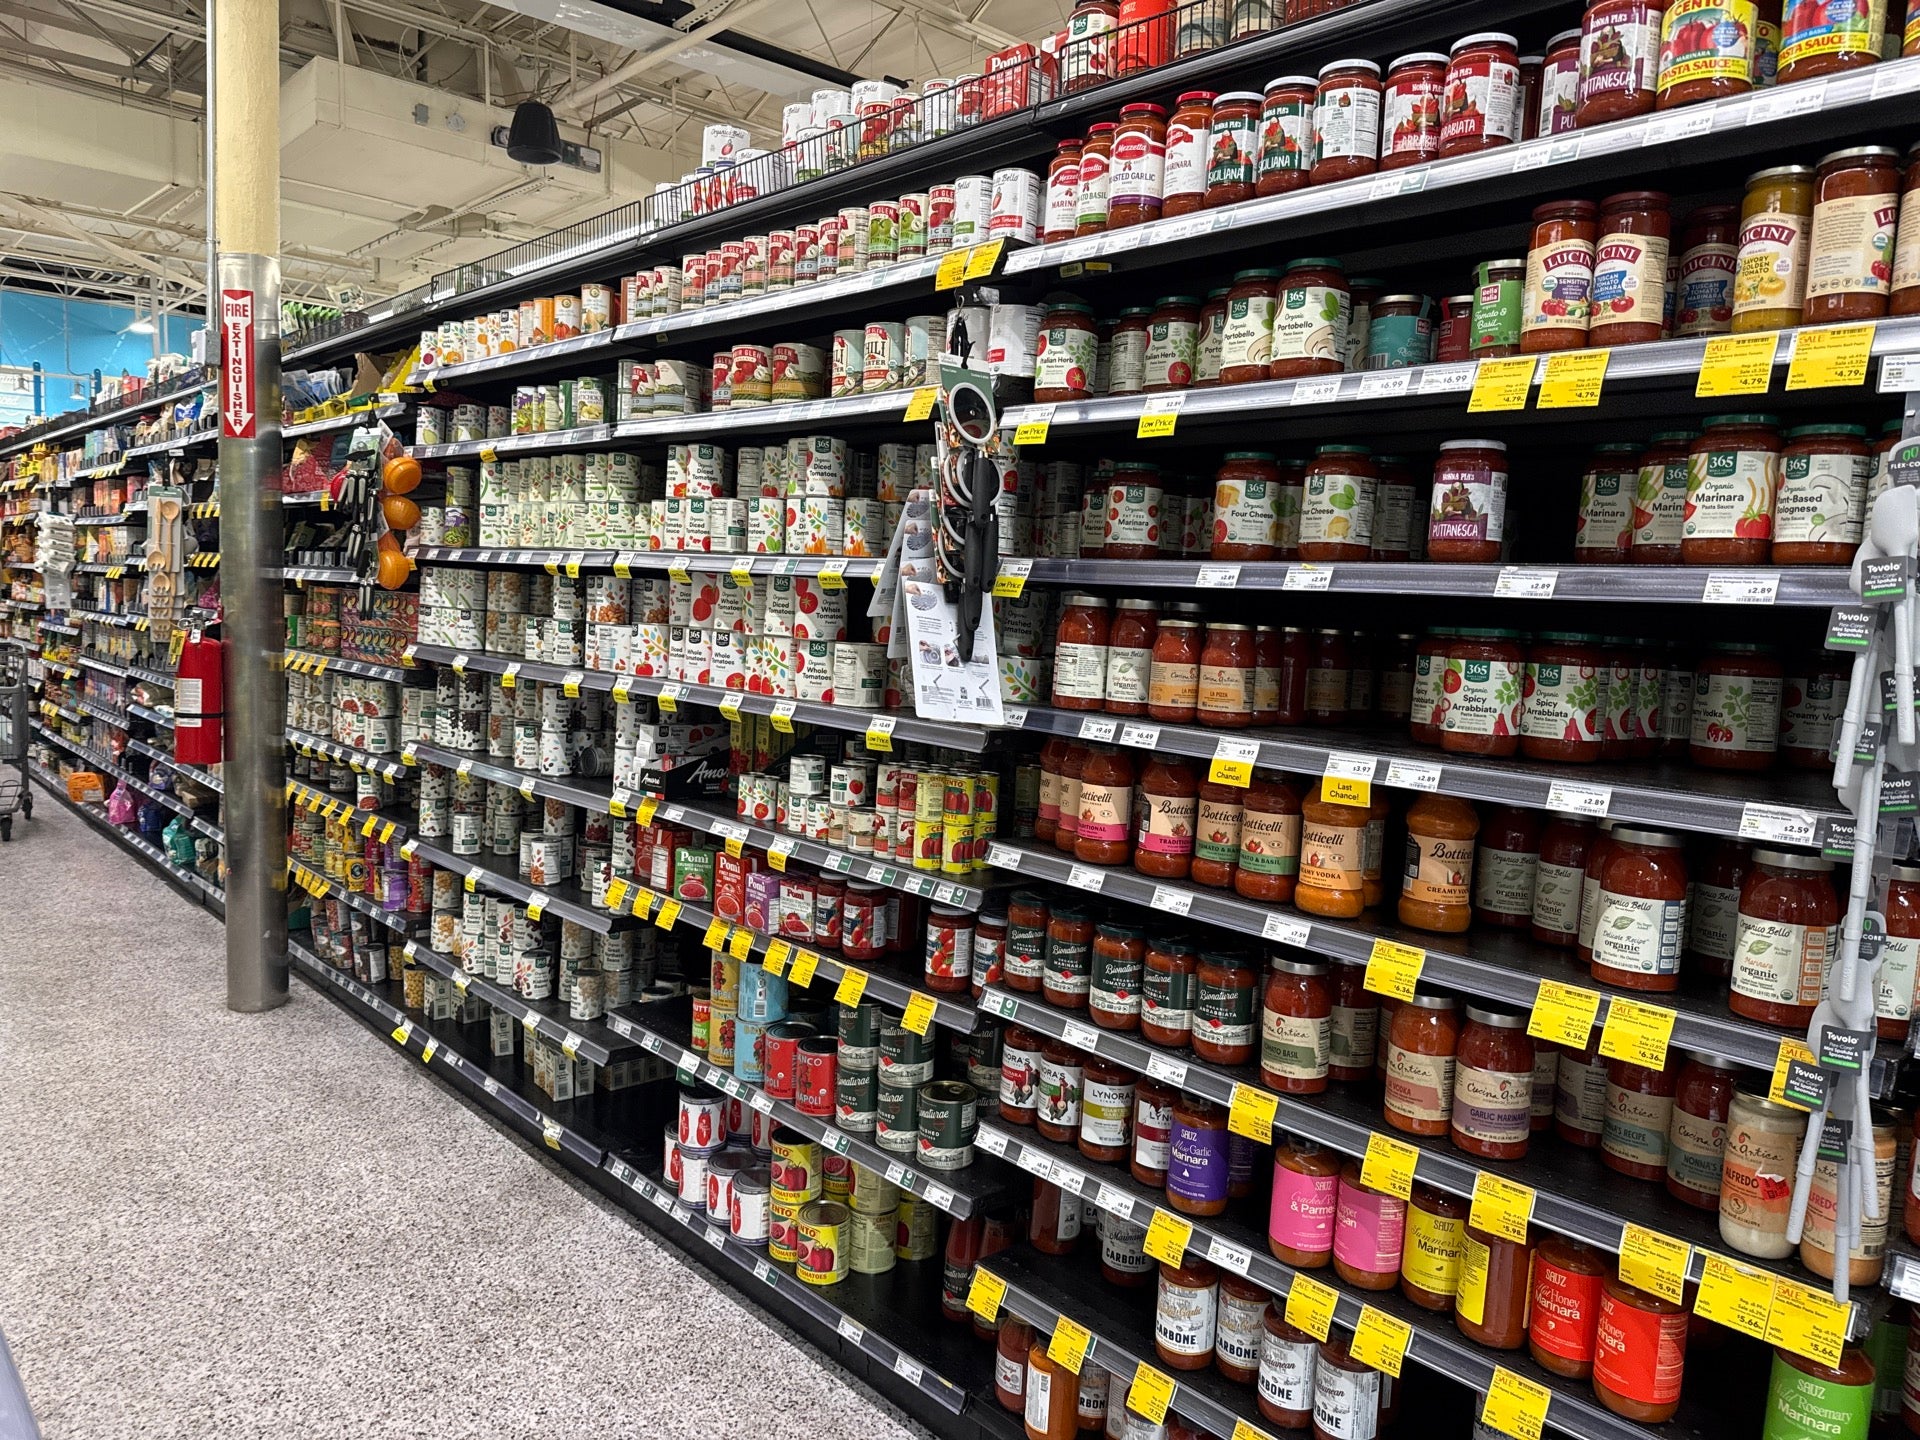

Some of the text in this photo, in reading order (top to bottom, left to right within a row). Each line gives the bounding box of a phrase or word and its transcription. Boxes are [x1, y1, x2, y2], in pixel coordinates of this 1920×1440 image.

[1805, 35, 1845, 52] SAUCE
[1676, 50, 1711, 62] MARINARA
[1661, 59, 1731, 82] PASTA SAUCE
[1117, 143, 1147, 153] Mezzetta
[1128, 172, 1156, 182] GARLIC
[1089, 192, 1107, 200] BASIL
[1743, 256, 1769, 266] SAVORY
[1742, 262, 1770, 272] GOLDEN
[1742, 268, 1769, 277] TOMATO
[1559, 278, 1588, 287] SENSITIVE
[1288, 291, 1304, 302] 365
[225, 303, 249, 318] FIRE
[1234, 302, 1247, 313] 365
[1285, 313, 1304, 322] Organic
[1277, 320, 1313, 332] Portobello
[1477, 319, 1501, 330] Basil
[1153, 325, 1167, 335] 365
[1224, 330, 1255, 340] Portobello
[1050, 331, 1064, 341] 365
[1800, 335, 1825, 344] SALE
[1708, 344, 1731, 352] SALE
[1160, 351, 1176, 359] Herb
[232, 322, 243, 427] EXTINGUISHER
[1381, 380, 1403, 390] $6.99
[1443, 375, 1467, 385] $6.99
[1313, 386, 1334, 397] $6.99
[1141, 418, 1173, 428] Low Price
[1018, 428, 1046, 437] Low Price
[817, 440, 830, 449] 365
[1710, 455, 1734, 468] 365
[1787, 460, 1807, 471] 365
[813, 463, 832, 471] Diced
[809, 470, 837, 478] Tomatoes
[1597, 477, 1617, 488] 365
[1705, 482, 1734, 491] Organic
[1128, 488, 1143, 498] 365
[1247, 483, 1264, 493] 365
[1784, 485, 1806, 493] Organic
[1695, 494, 1744, 503] Marinara
[1244, 501, 1264, 510] Organic
[1593, 500, 1617, 508] Organic
[1311, 507, 1334, 515] Cheese
[1585, 509, 1625, 518] Marinara
[1777, 505, 1818, 514] Bolognese
[1231, 510, 1274, 520] Four Cheese
[1118, 518, 1149, 527] Marinara
[1432, 523, 1478, 538] PUTTANESCA
[1867, 563, 1901, 573] Tovolo
[775, 577, 789, 586] 365
[995, 581, 1022, 589] Low Price
[773, 601, 790, 609] Diced
[821, 606, 841, 614] Whole
[769, 607, 795, 615] Tomatoes
[1838, 612, 1870, 621] Tovolo
[717, 633, 729, 642] 365
[811, 642, 827, 652] 365
[712, 658, 735, 666] Tomatoes
[807, 667, 828, 675] Whole
[1466, 664, 1487, 676] 365
[1539, 668, 1559, 680] 365
[802, 673, 832, 681] Tomatoes
[1113, 682, 1137, 691] organic
[1463, 685, 1488, 694] Organic
[1536, 690, 1559, 698] Organic
[1463, 694, 1487, 705] Spicy
[1536, 699, 1558, 709] Spicy
[1452, 704, 1497, 714] Arrabbiata
[1526, 707, 1568, 718] Arrabbiata
[1702, 710, 1723, 718] Vodka
[1096, 727, 1112, 735] $9.49
[1137, 732, 1154, 741] $6.49
[1239, 749, 1255, 757] $3.97
[1224, 765, 1237, 773] Last
[1353, 765, 1371, 774] $3.97
[1216, 772, 1242, 782] Chance!
[1417, 775, 1436, 783] $2.89
[1337, 783, 1352, 792] Last
[1880, 780, 1911, 788] Tovolo
[1330, 791, 1359, 801] Chance!
[1584, 798, 1605, 807] $2.89
[1784, 825, 1809, 834] $2.59
[1261, 858, 1281, 866] BASIL
[1316, 871, 1341, 880] VODKA
[1427, 886, 1458, 895] CREAMY
[1496, 889, 1528, 898] organic
[1604, 895, 1651, 911] Organico Bello
[1740, 920, 1791, 938] Organico Bello
[1012, 930, 1044, 940] Bionaturae
[1291, 931, 1307, 939] $7.59
[1013, 944, 1040, 953] MARINARA
[1605, 939, 1640, 952] organic
[1054, 961, 1083, 969] MARINARA
[1744, 957, 1773, 969] Marinara
[1740, 965, 1778, 981] organic
[1541, 987, 1560, 997] SALE
[1614, 1004, 1632, 1016] SALE
[1827, 1031, 1859, 1045] Tovolo
[1282, 1049, 1298, 1059] BASIL
[1781, 1046, 1805, 1060] SALE
[1170, 1070, 1183, 1079] $9.69
[1794, 1066, 1824, 1082] Tovolo
[1392, 1085, 1411, 1096] VODKA
[1467, 1082, 1498, 1099] Cucina
[1470, 1108, 1527, 1123] GARLIC MARINARA
[1181, 1129, 1197, 1142] SAUZ
[1624, 1128, 1646, 1142] RECIPE
[1678, 1125, 1709, 1145] Cucina
[1190, 1145, 1211, 1156] Garlic
[1172, 1148, 1208, 1166] Marinara
[1684, 1154, 1716, 1172] NONNA'S
[1725, 1165, 1759, 1189] ALFREDO
[1315, 1181, 1332, 1191] SAUZ
[1479, 1179, 1496, 1190] SALE
[1291, 1202, 1298, 1212] &
[1434, 1219, 1454, 1233] SAUZ
[1626, 1231, 1647, 1244] SALE
[1106, 1247, 1147, 1266] CARBONE
[1226, 1253, 1245, 1266] $9.49
[1707, 1258, 1729, 1274] SALE
[1545, 1268, 1567, 1288] SAUZ
[1777, 1285, 1802, 1300] SALE
[1551, 1290, 1580, 1309] Honey
[1699, 1298, 1710, 1306] with
[1535, 1292, 1580, 1320] Marinara
[1770, 1325, 1782, 1334] with
[1157, 1324, 1197, 1346] CARBONE
[1797, 1378, 1826, 1400] SAUZ
[1798, 1396, 1853, 1425] Rosemary
[1778, 1398, 1842, 1434] Marinara
